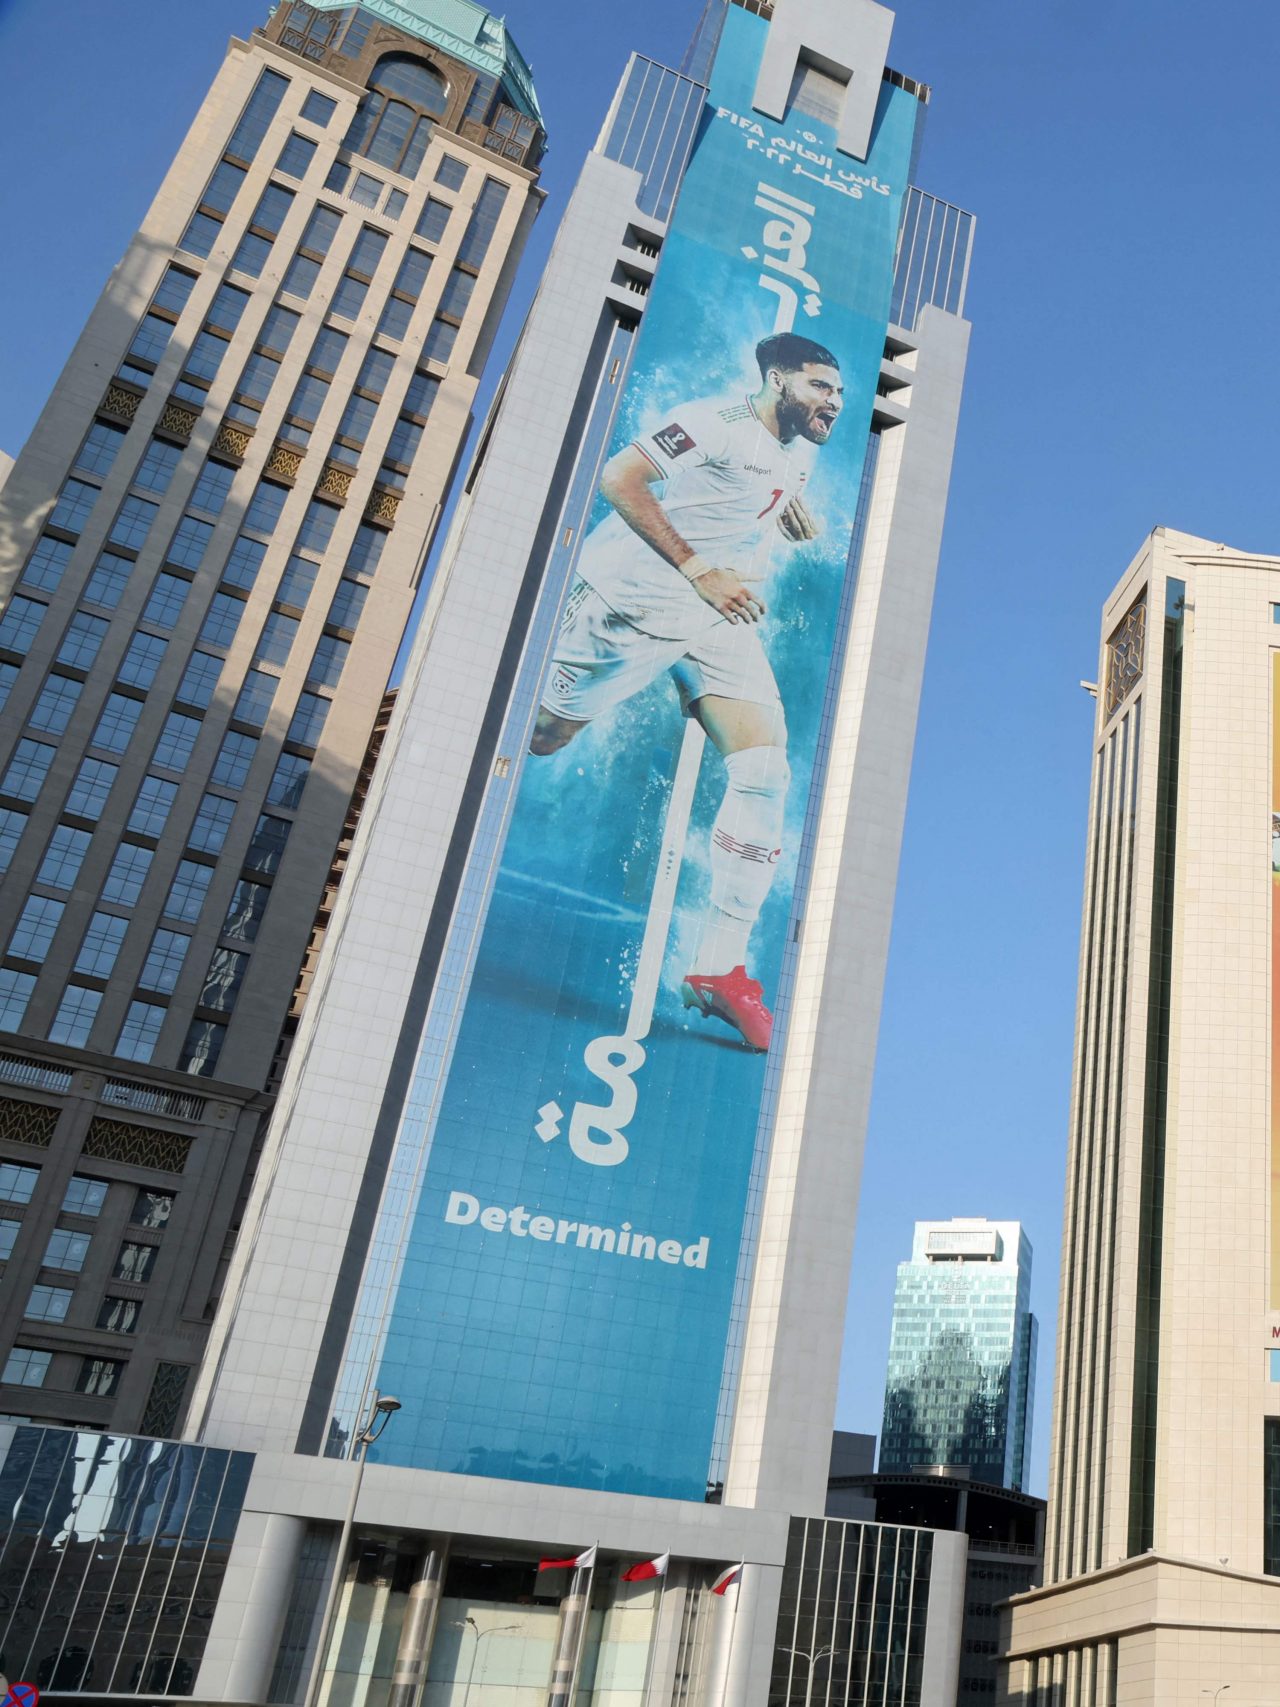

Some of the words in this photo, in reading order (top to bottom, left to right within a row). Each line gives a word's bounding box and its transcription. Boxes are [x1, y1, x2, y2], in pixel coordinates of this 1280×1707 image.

[716, 107, 765, 138] FIFA
[771, 136, 832, 170] العالم
[744, 464, 772, 475] uhlsport
[443, 1190, 710, 1270] Determined
